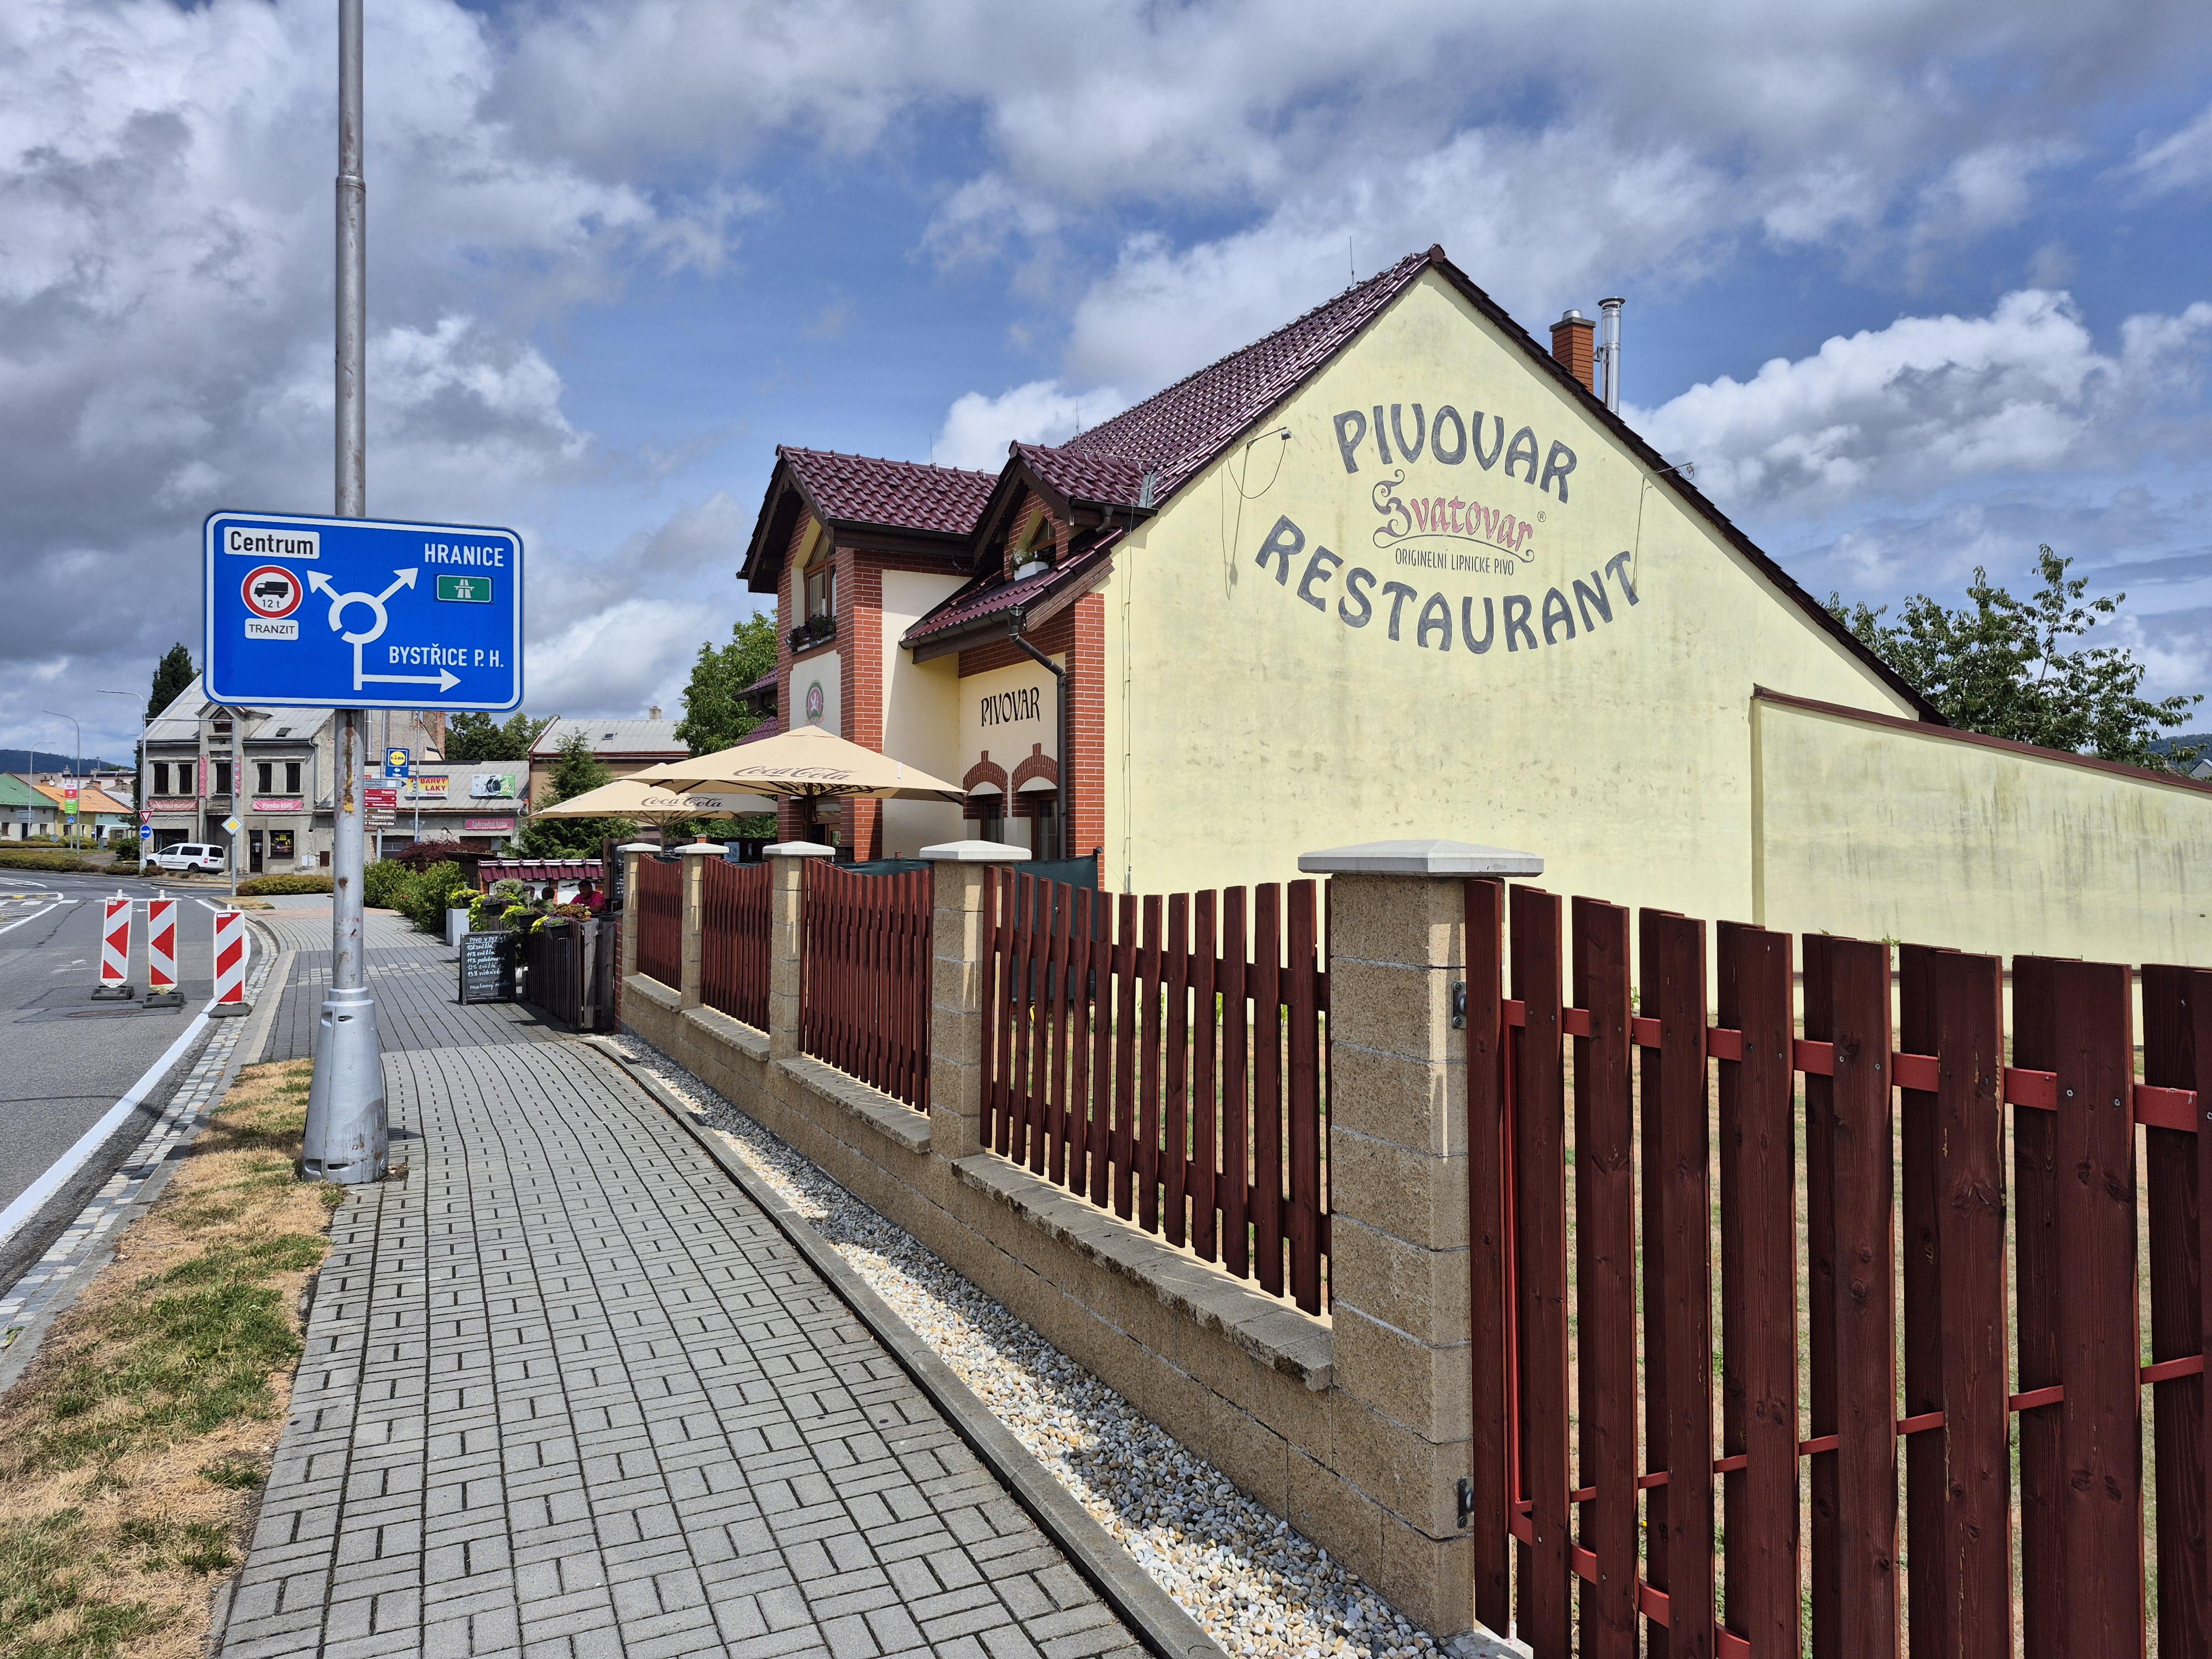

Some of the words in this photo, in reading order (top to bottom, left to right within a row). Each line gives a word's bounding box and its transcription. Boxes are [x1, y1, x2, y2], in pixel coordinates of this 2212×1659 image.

[1333, 403, 1577, 504] PIVOVAR
[1372, 469, 1533, 552] Svatovar
[231, 531, 314, 555] Centrum
[425, 543, 504, 567] HRANICE
[1395, 548, 1448, 570] ORIGINELNÍ
[1451, 554, 1490, 573] LIPNICKÉ
[1494, 558, 1514, 576] PIVO
[1255, 514, 1640, 654] RESTAURANT
[262, 599, 274, 608] 12
[249, 624, 295, 634] TRANZIT
[389, 643, 468, 666] BYSTŘICE
[474, 649, 484, 667] P.
[489, 650, 504, 667] H.
[981, 686, 1040, 727] PIVOVAR
